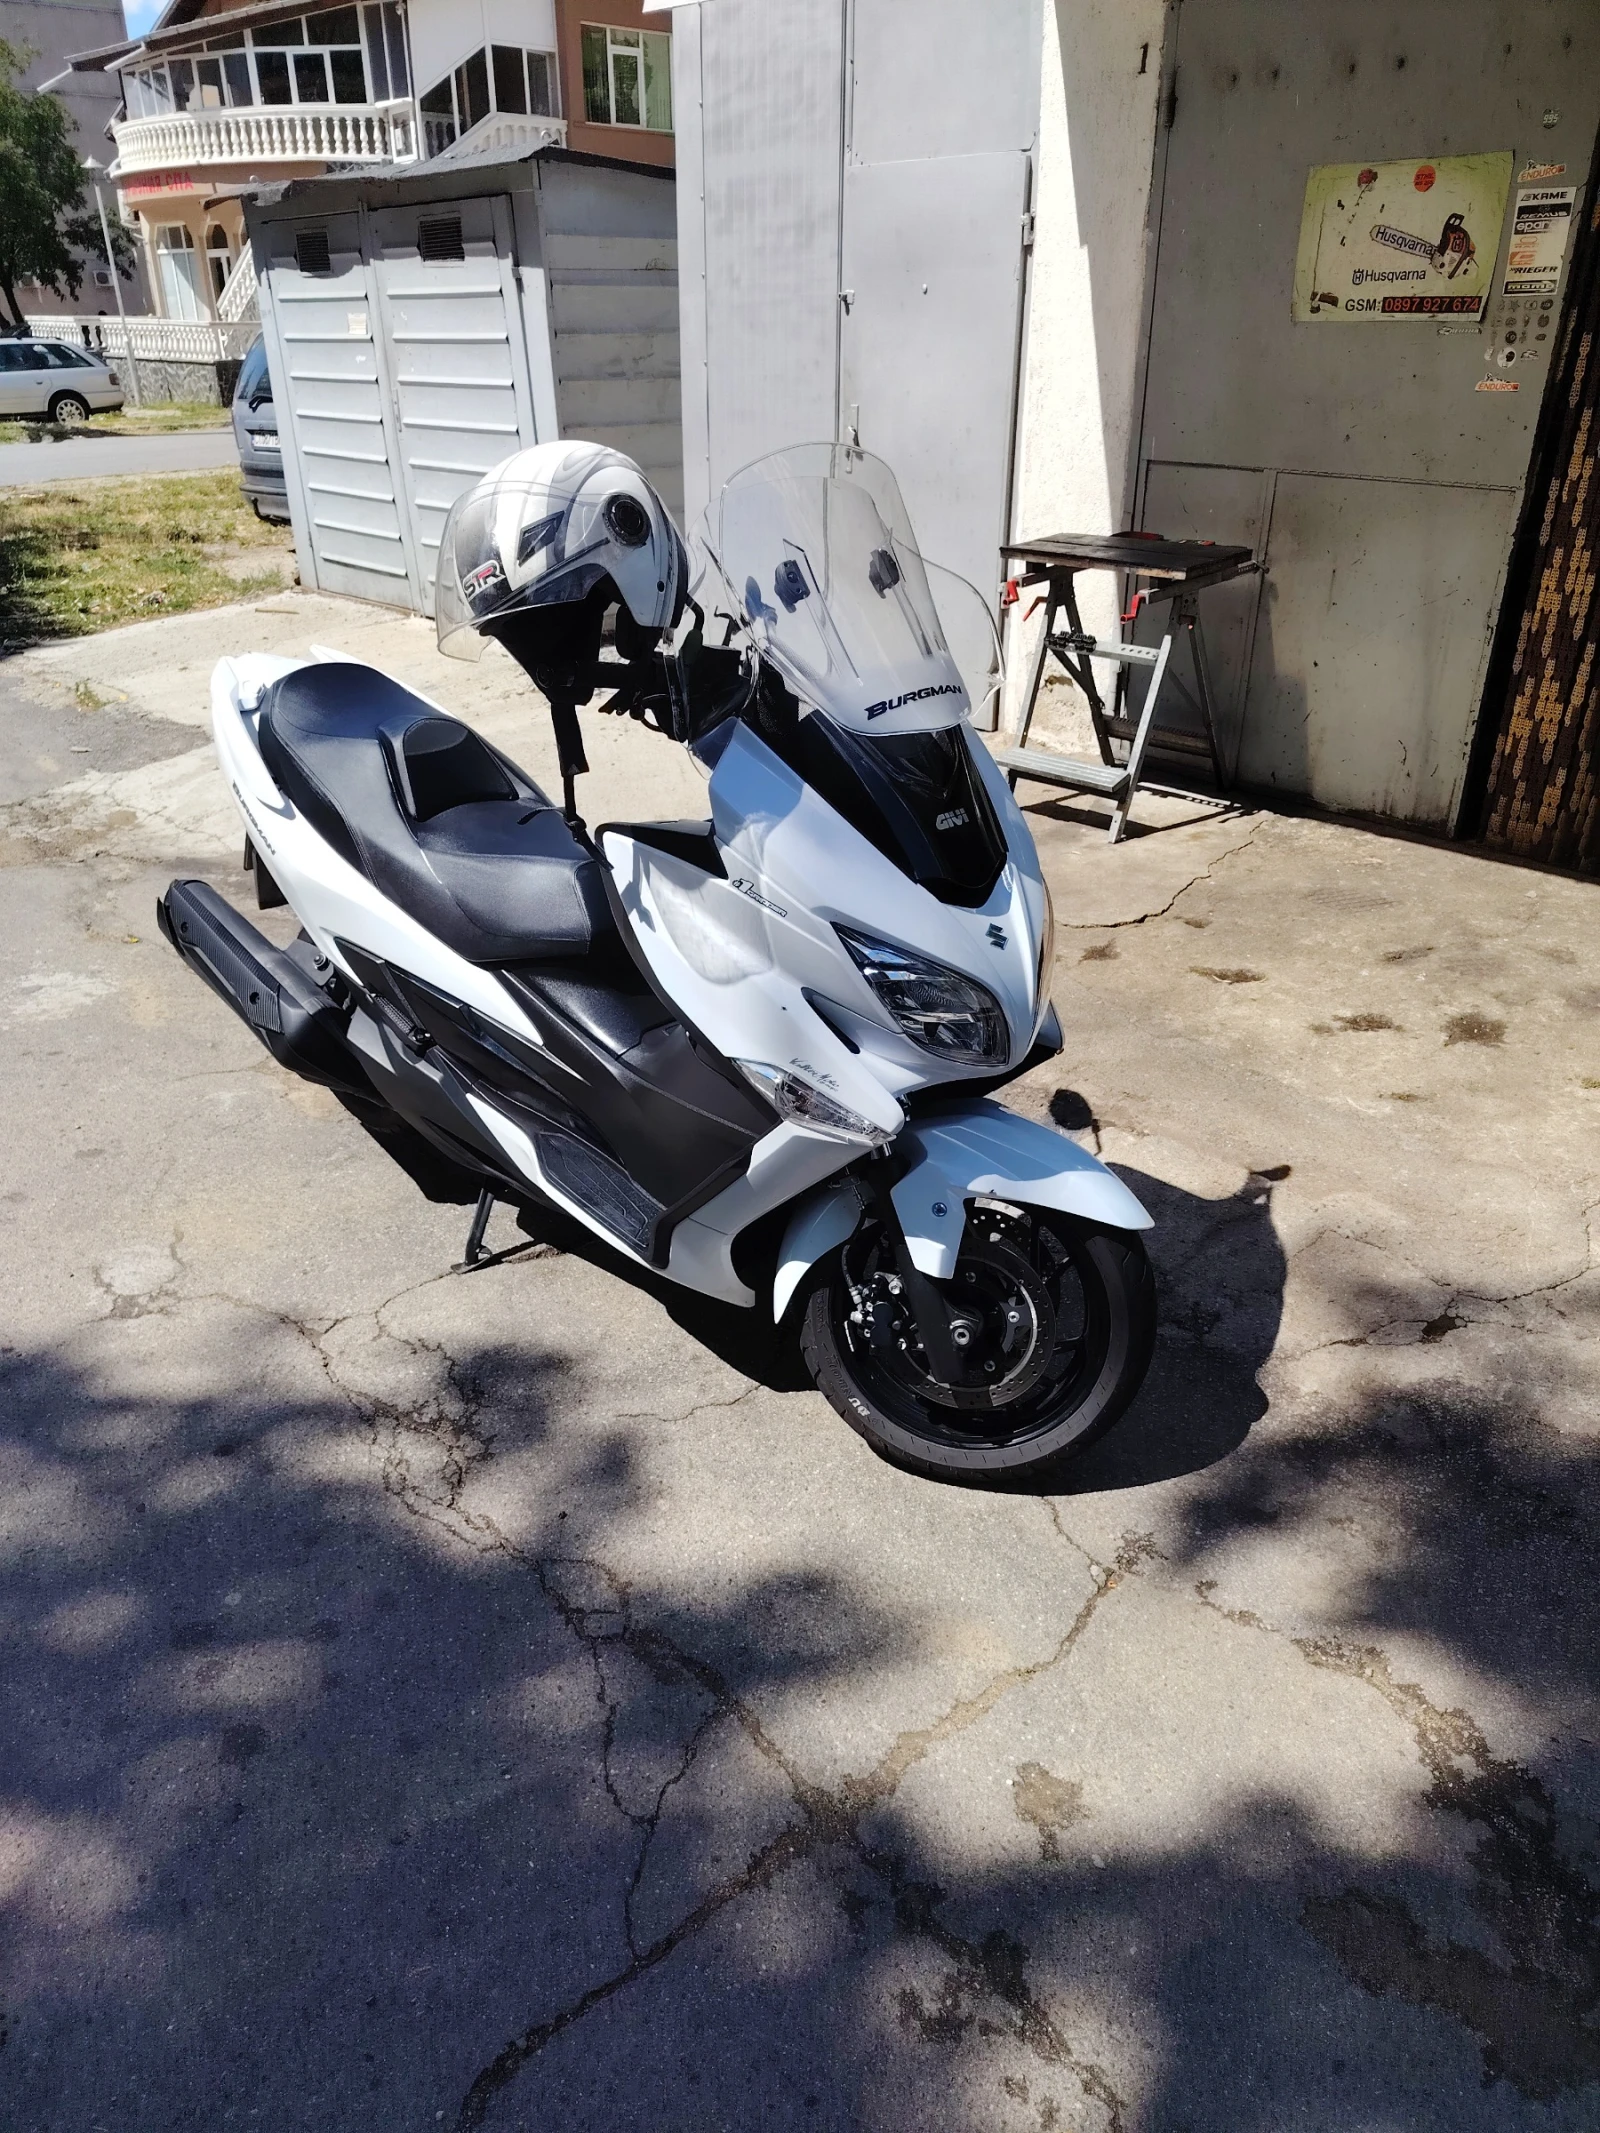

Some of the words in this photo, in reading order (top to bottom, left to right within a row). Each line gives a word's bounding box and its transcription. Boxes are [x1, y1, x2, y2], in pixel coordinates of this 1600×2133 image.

[1138, 42, 1149, 75] 1
[1520, 166, 1560, 181] ENDURO
[1375, 226, 1436, 257] Husqvarna
[1364, 269, 1426, 283] Husqvarna
[1344, 298, 1381, 312] GSM:
[1384, 297, 1420, 312] 0897
[1423, 297, 1451, 312] 927
[1452, 297, 1480, 312] 674
[1478, 382, 1513, 391] ENDURO
[864, 684, 963, 721] BURGMAN
